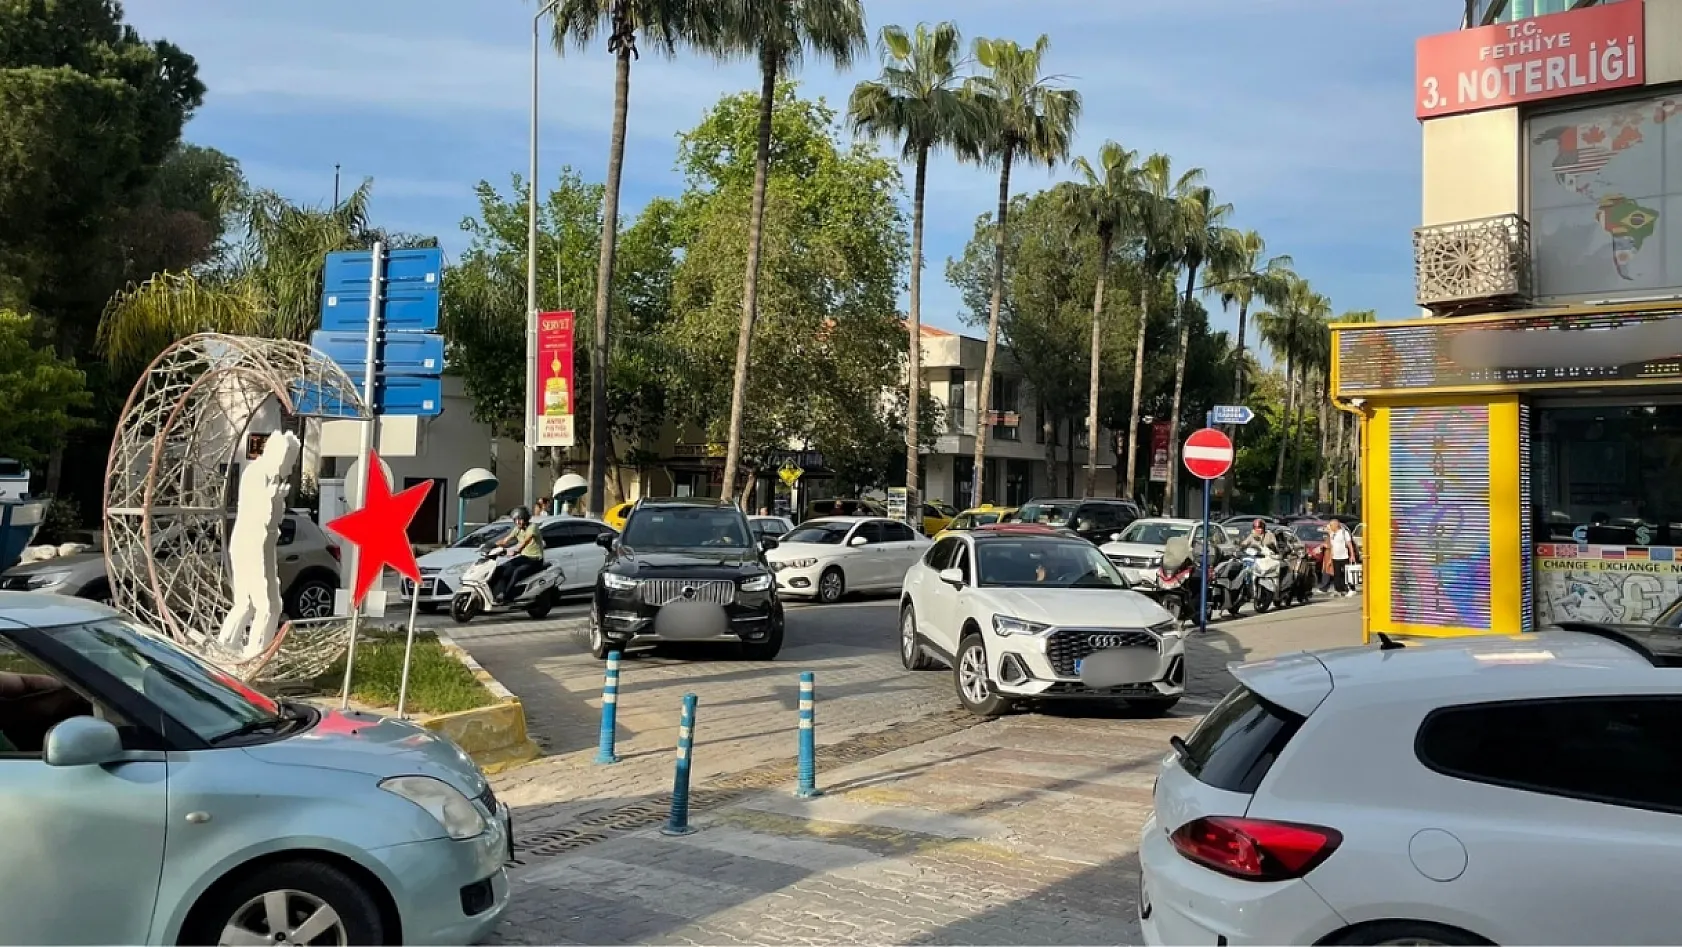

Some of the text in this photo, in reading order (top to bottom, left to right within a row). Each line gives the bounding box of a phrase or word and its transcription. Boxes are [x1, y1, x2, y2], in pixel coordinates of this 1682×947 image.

[1506, 21, 1542, 38] T.C.
[1479, 32, 1571, 61] FETHİYE
[1422, 36, 1636, 109] 3. NOTERLİĞİ
[1543, 559, 1589, 570] CHANGE
[1599, 561, 1661, 573] EXCHANGE
